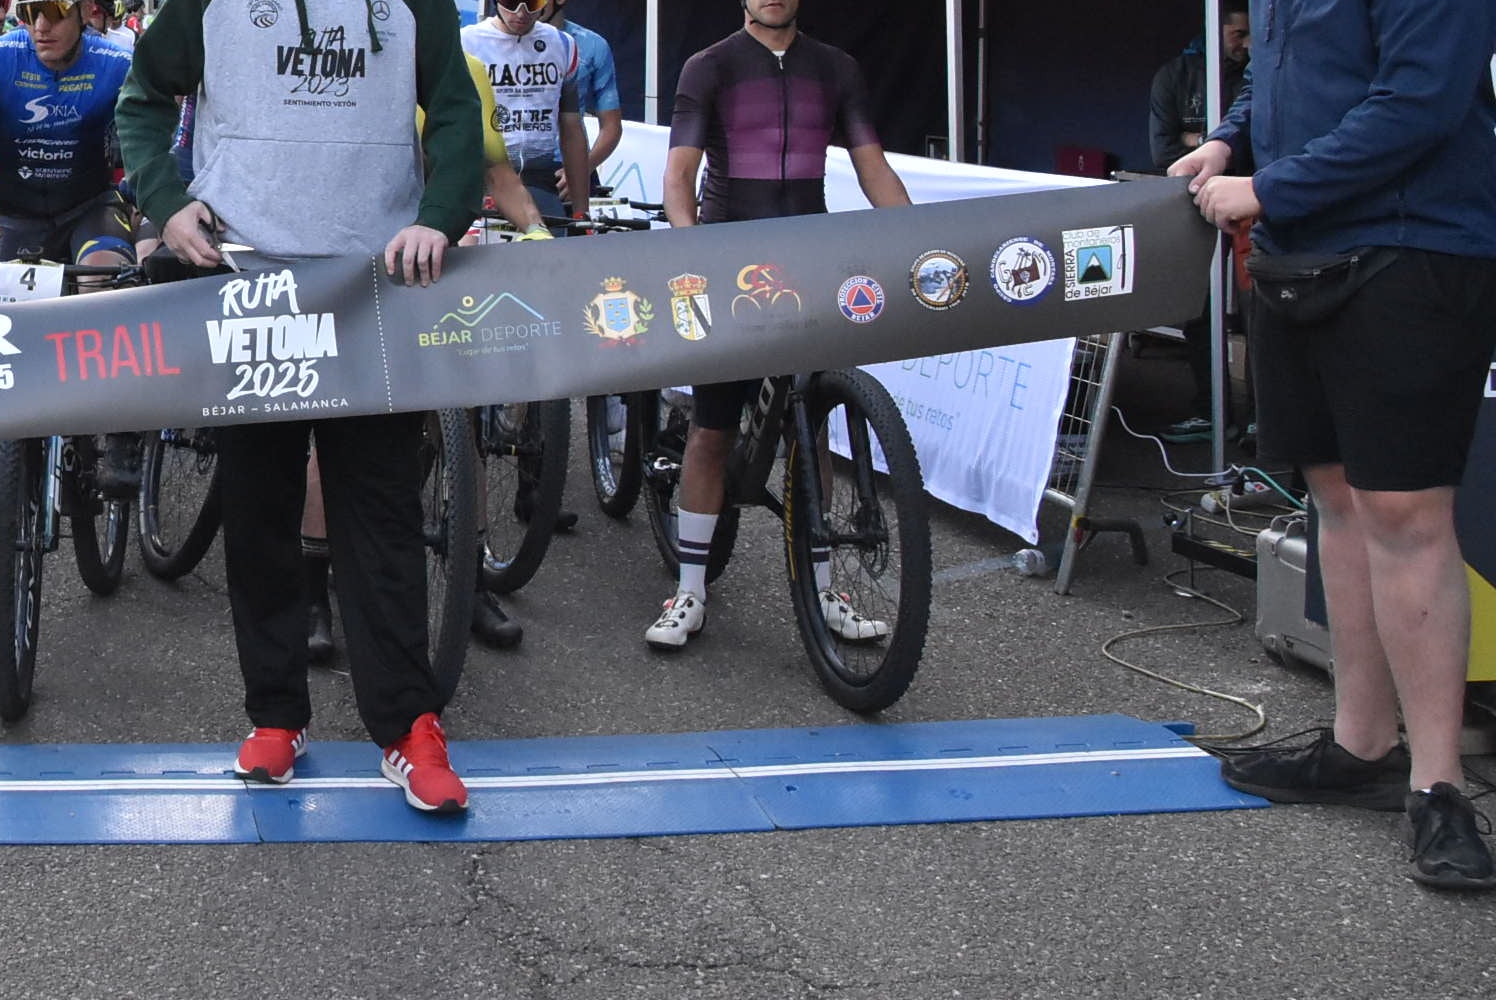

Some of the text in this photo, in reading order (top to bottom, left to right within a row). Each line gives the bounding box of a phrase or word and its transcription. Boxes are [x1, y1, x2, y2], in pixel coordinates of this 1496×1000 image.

[276, 45, 366, 78] VETONA
[290, 74, 350, 97] 2023
[17, 147, 74, 161] victoria
[18, 266, 37, 291] 4
[1065, 248, 1076, 288] SIERRA
[217, 269, 299, 317] RUTA
[1065, 287, 1081, 299] de
[205, 312, 338, 364] VETONA
[418, 321, 562, 347] BÉJAR DEPORTE
[44, 320, 181, 383] TRAIL
[225, 358, 321, 400] 2025
[901, 350, 1032, 411] PORTE
[201, 403, 246, 417] BÉJAR
[264, 398, 350, 415] SALAMANCA
[906, 399, 923, 419] tus
